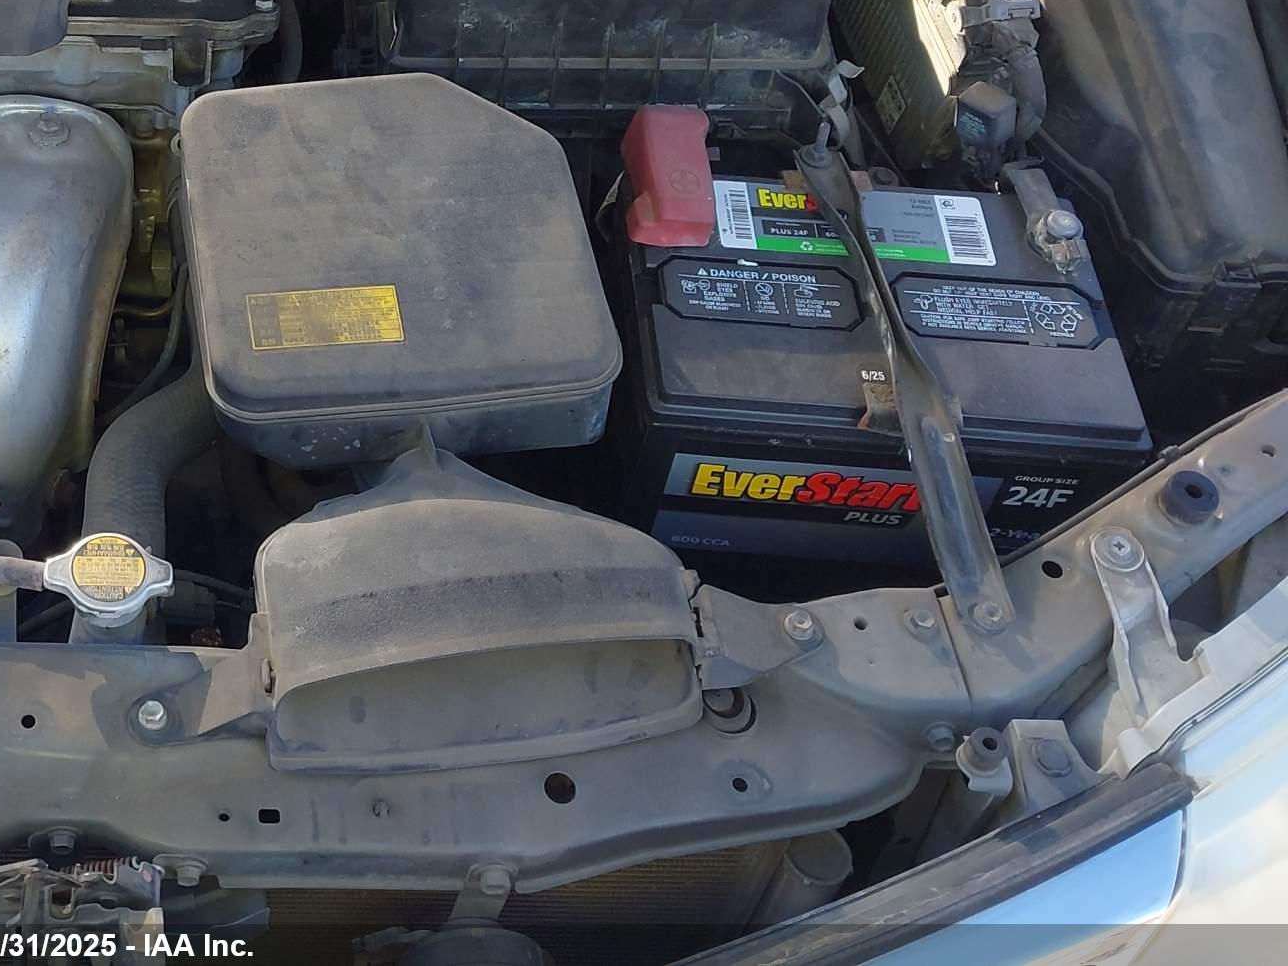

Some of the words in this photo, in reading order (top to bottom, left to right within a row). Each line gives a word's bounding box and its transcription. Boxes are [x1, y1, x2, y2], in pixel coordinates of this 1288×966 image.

[770, 227, 792, 235] PLUS
[710, 268, 759, 280] DANGER
[762, 272, 769, 280] /
[772, 273, 817, 283] POISON
[973, 298, 1013, 307] IMMEDIATELY
[861, 370, 885, 382] 6/25
[1014, 475, 1054, 483] GROUP
[1002, 486, 1074, 508] 24F
[843, 511, 903, 525] PLUS
[990, 528, 1042, 540] 2-Yea
[671, 535, 700, 544] 600
[702, 538, 730, 546] CCA
